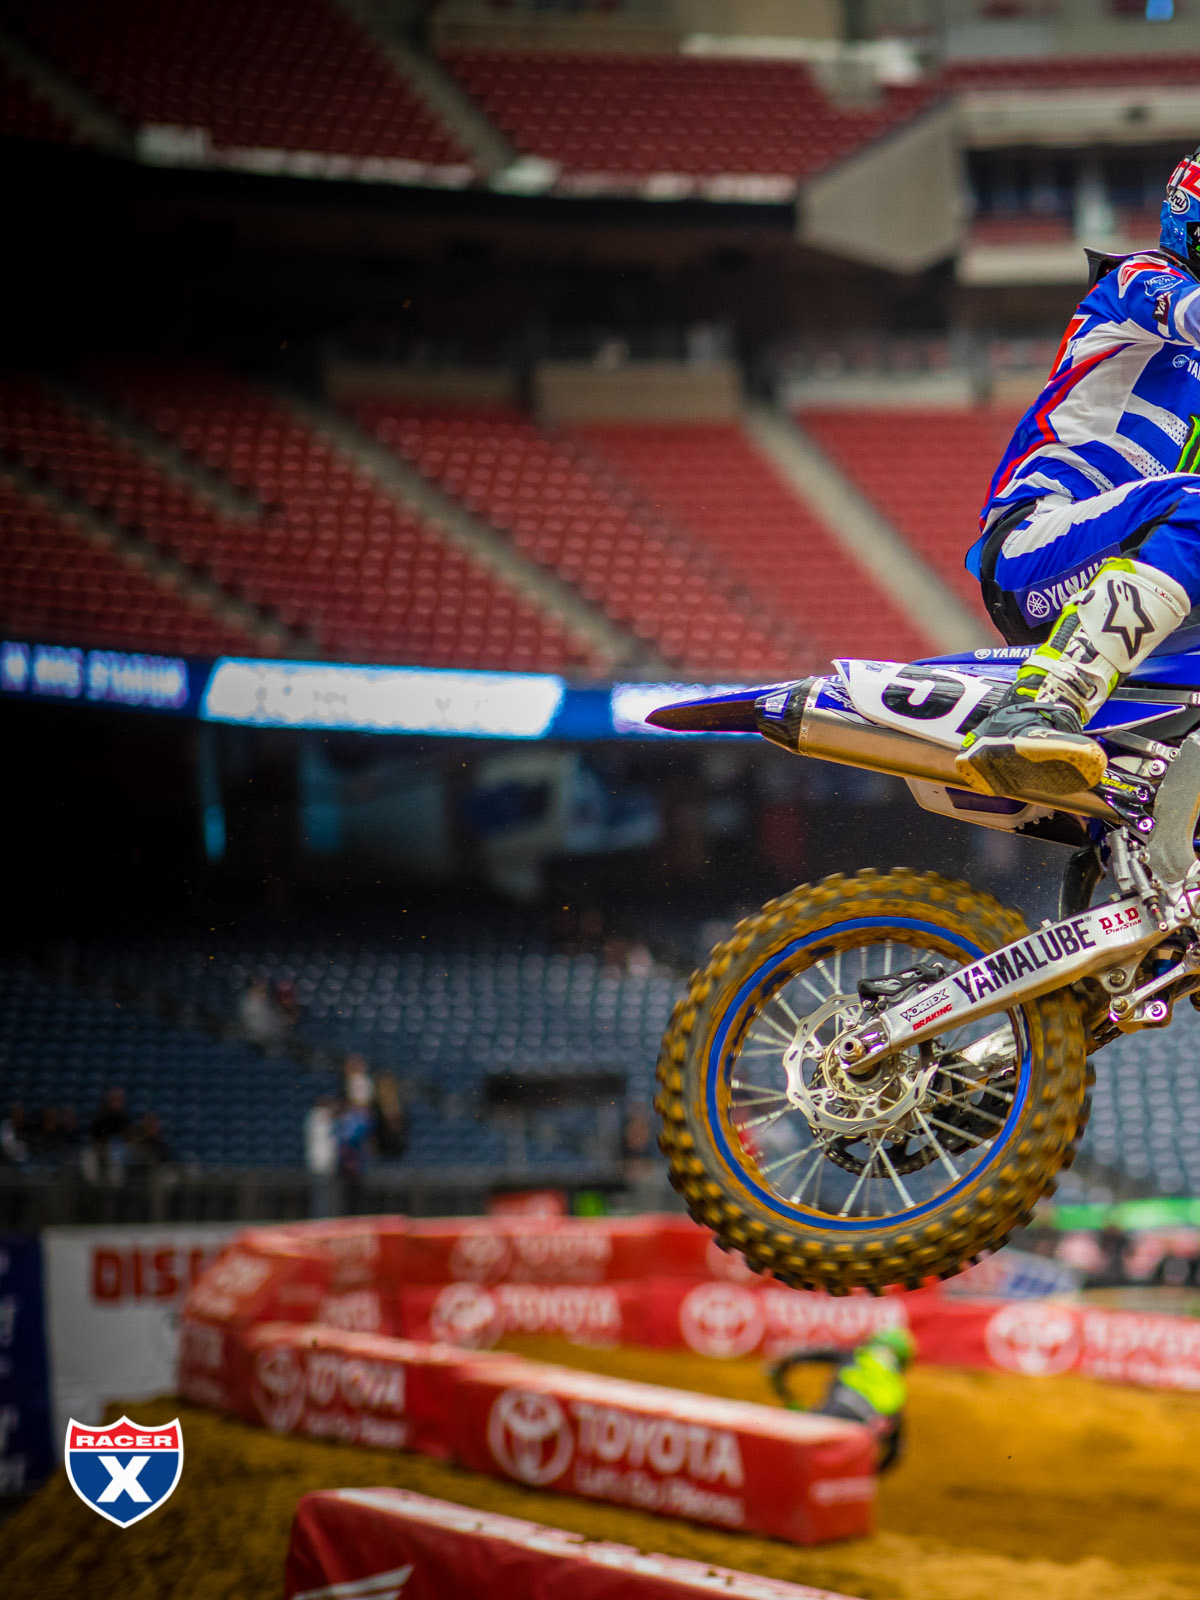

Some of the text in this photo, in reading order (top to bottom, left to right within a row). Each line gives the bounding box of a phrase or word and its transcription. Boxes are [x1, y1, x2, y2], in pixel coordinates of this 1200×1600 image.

[952, 919, 1096, 1004] YAMALUBE
[900, 988, 950, 1022] VORTEX
[912, 1004, 953, 1031] BRAKING
[574, 1403, 745, 1487] TOYOTA
